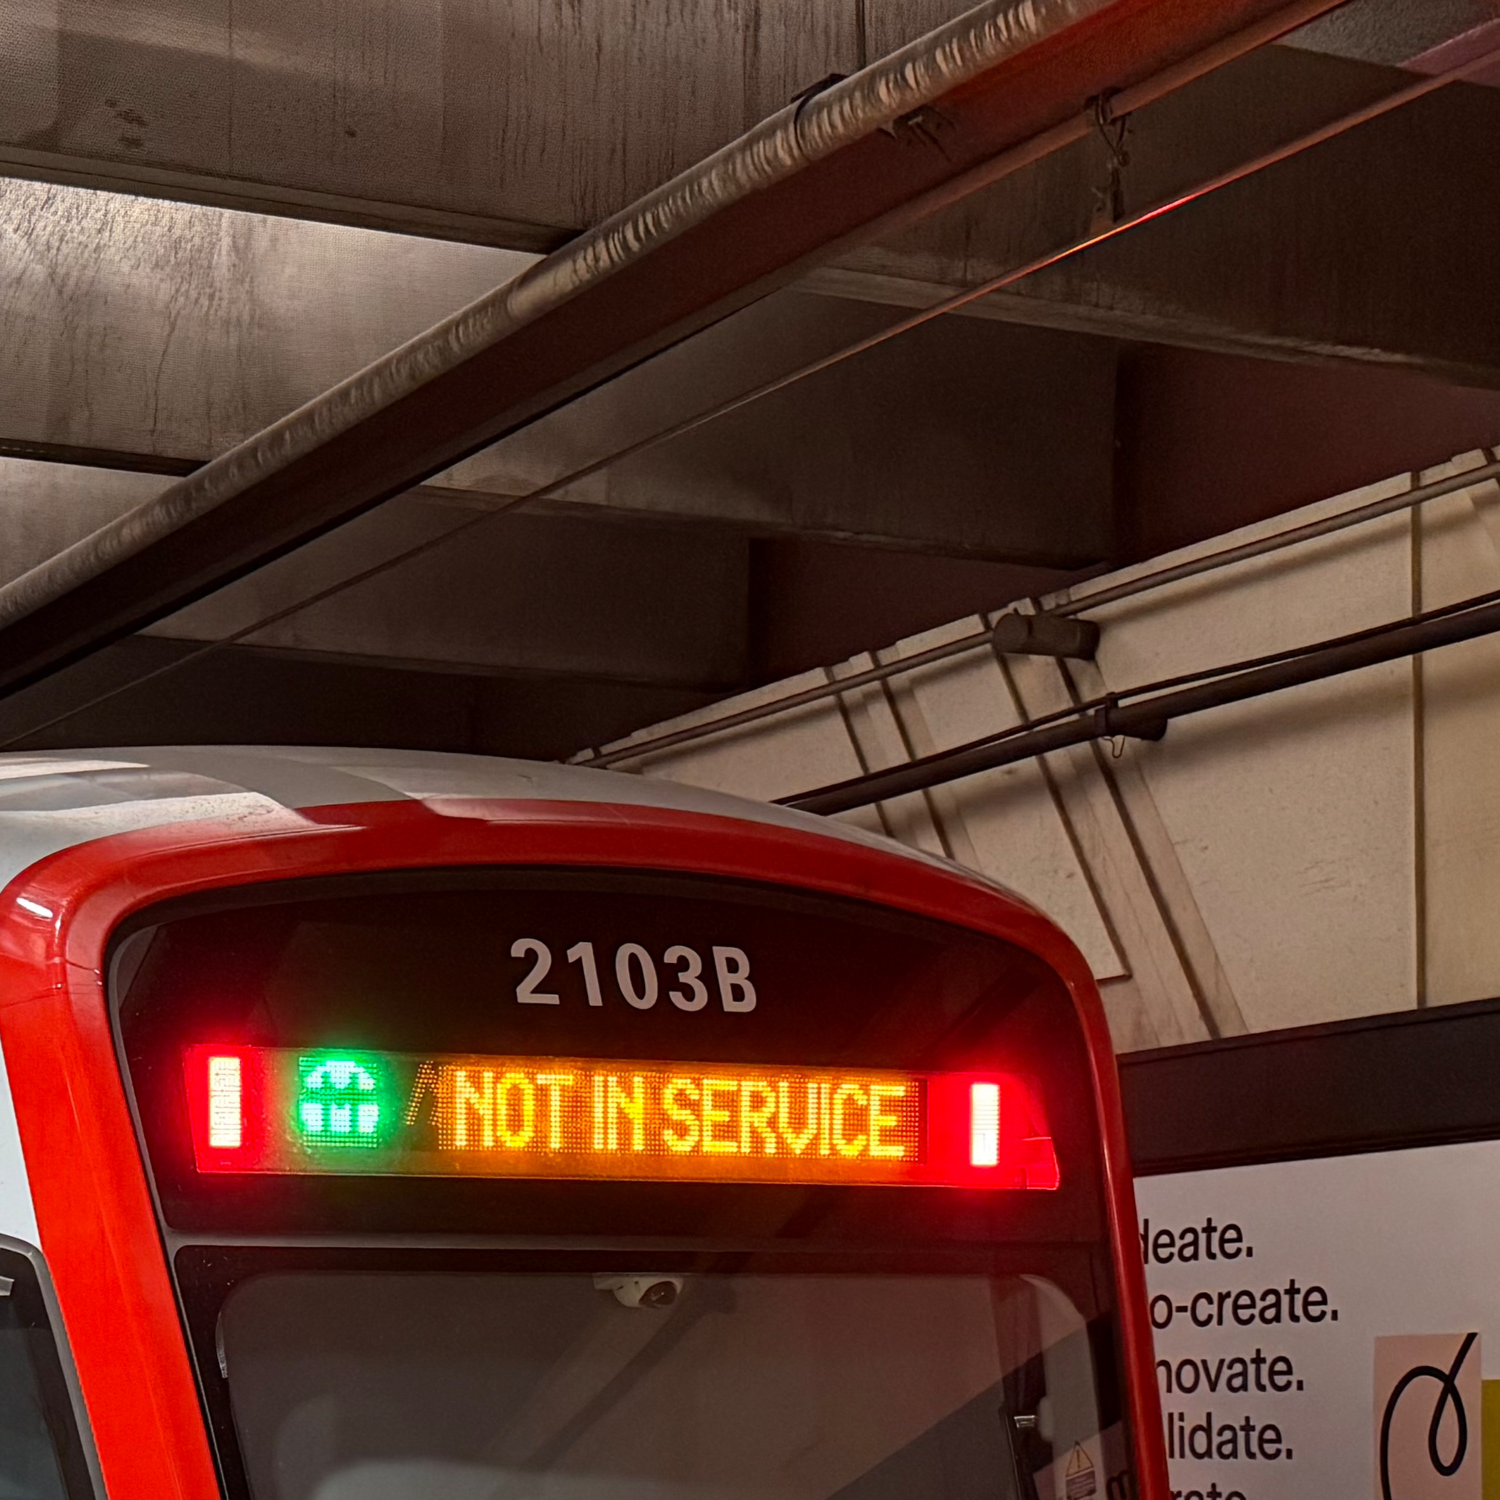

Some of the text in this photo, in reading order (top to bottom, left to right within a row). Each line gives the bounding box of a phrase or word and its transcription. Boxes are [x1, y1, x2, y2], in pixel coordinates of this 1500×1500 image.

[510, 937, 758, 1013] 2103B
[454, 1071, 906, 1156] NOT IN SERVICE
[1149, 1279, 1340, 1330] o-create.
[1156, 1348, 1305, 1394] novate.
[1167, 1411, 1294, 1461] lidate.
